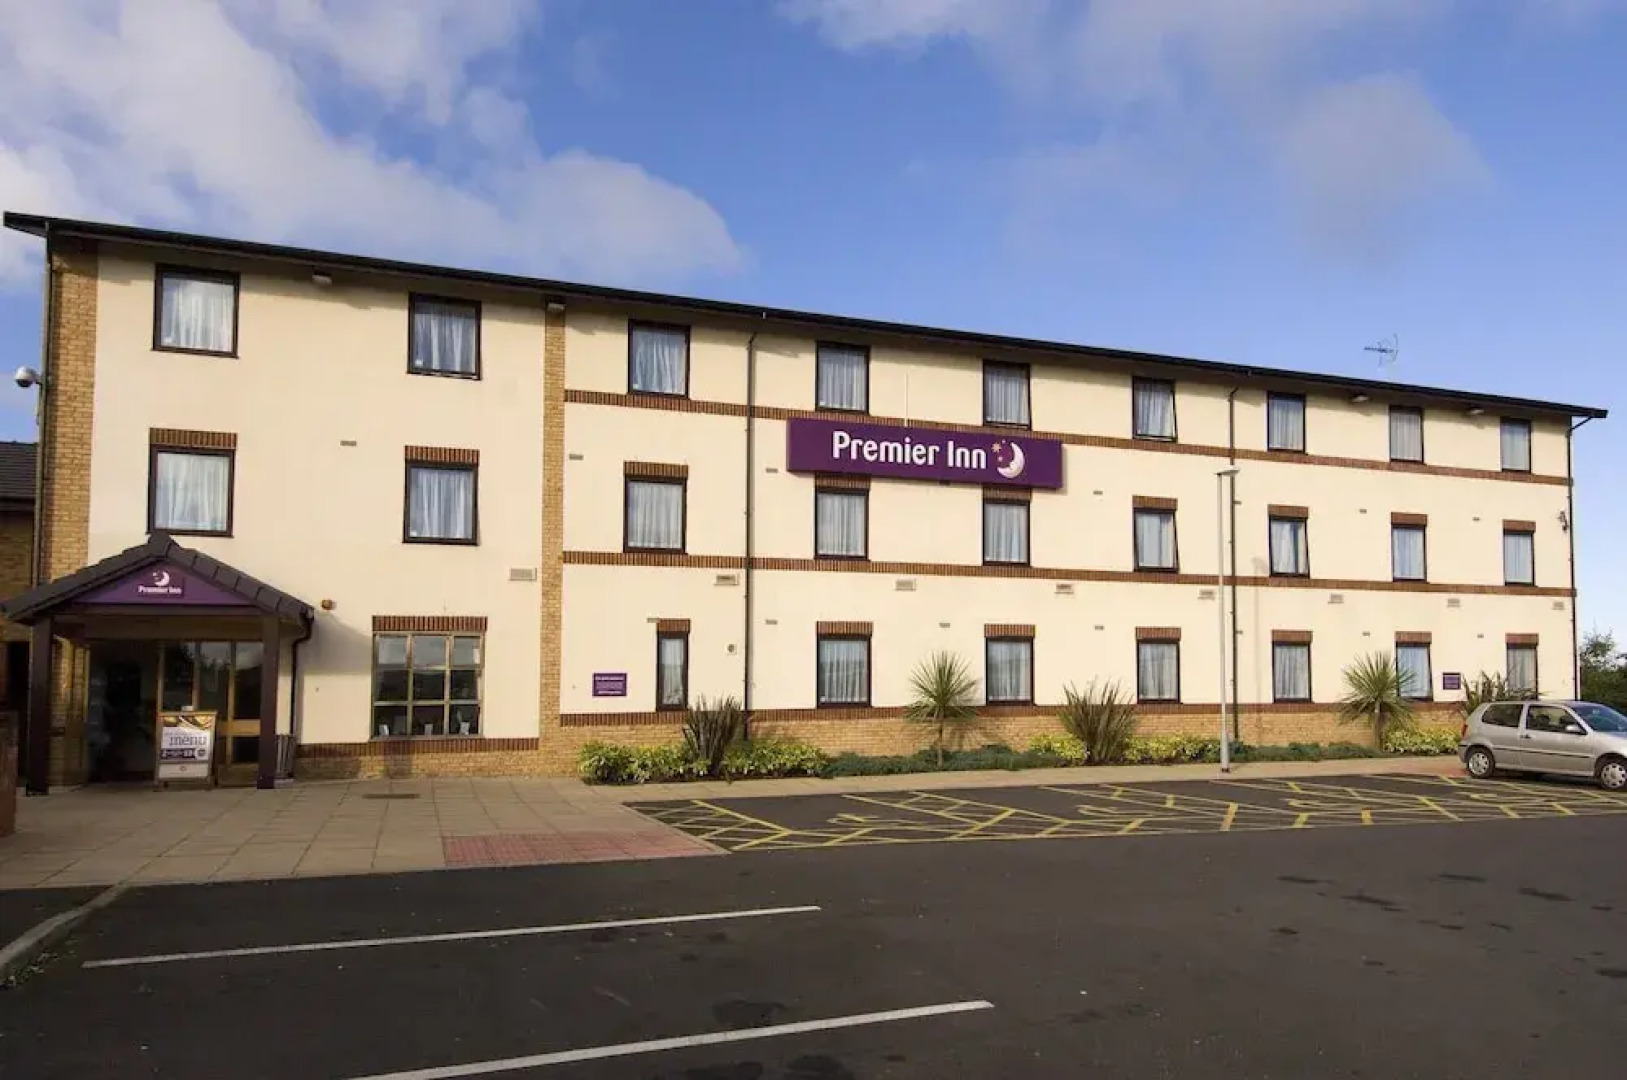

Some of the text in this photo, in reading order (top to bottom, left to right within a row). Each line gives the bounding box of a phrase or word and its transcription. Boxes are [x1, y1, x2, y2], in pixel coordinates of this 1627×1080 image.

[832, 430, 987, 469] Premier Inn
[138, 585, 182, 594] Premier Inn
[169, 736, 207, 746] menu
